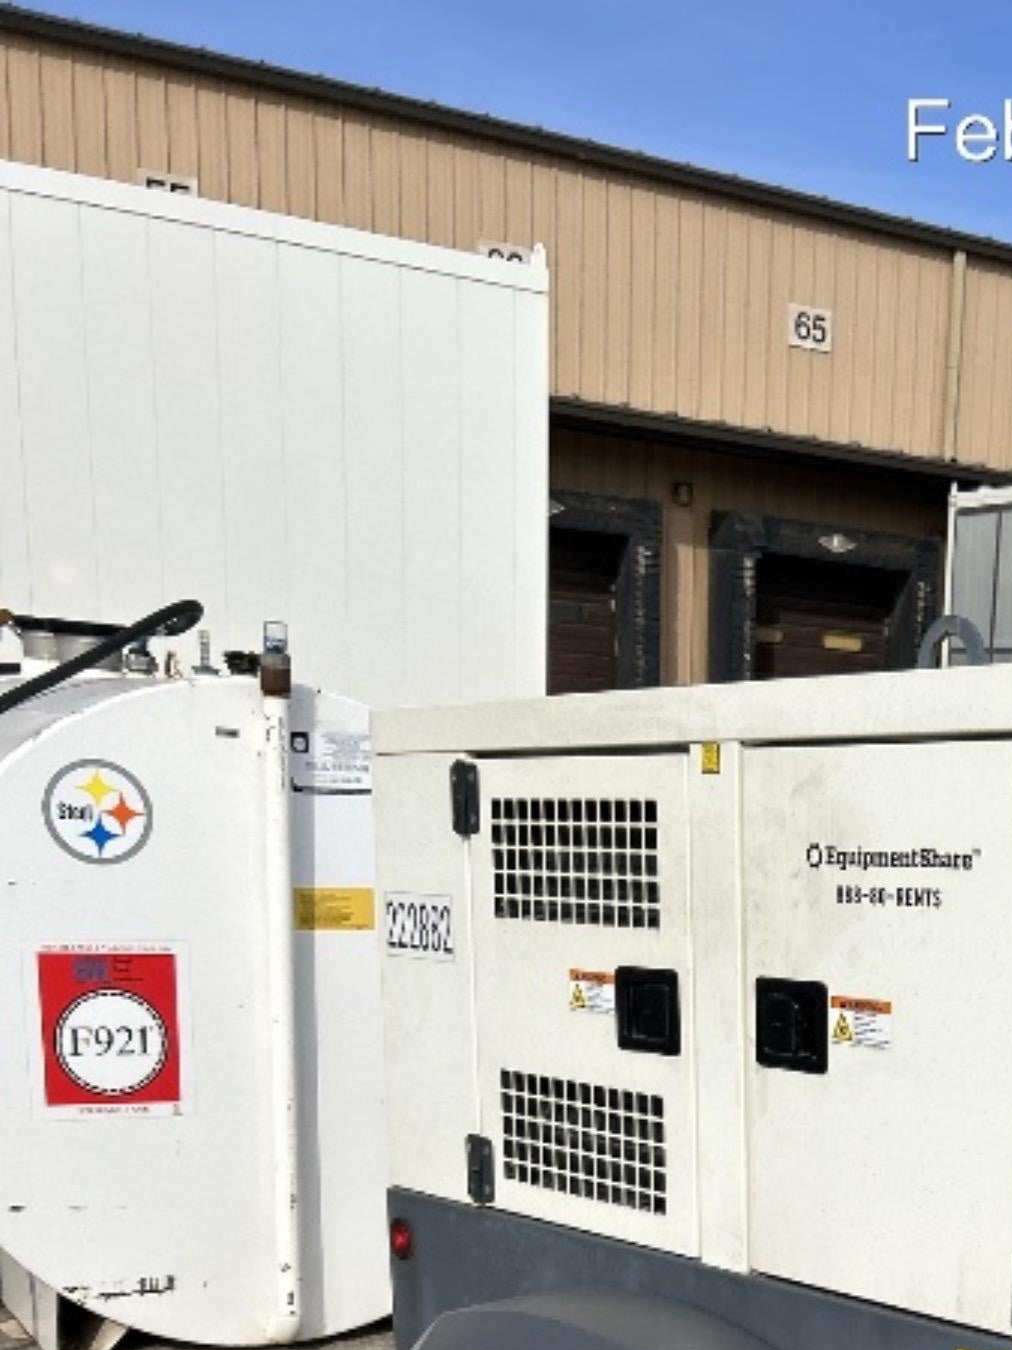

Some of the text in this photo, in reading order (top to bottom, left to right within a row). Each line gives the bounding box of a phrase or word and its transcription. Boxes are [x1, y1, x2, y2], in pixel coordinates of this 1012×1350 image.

[794, 311, 827, 344] 65
[386, 900, 454, 955] 222882
[68, 1025, 154, 1057] F921
